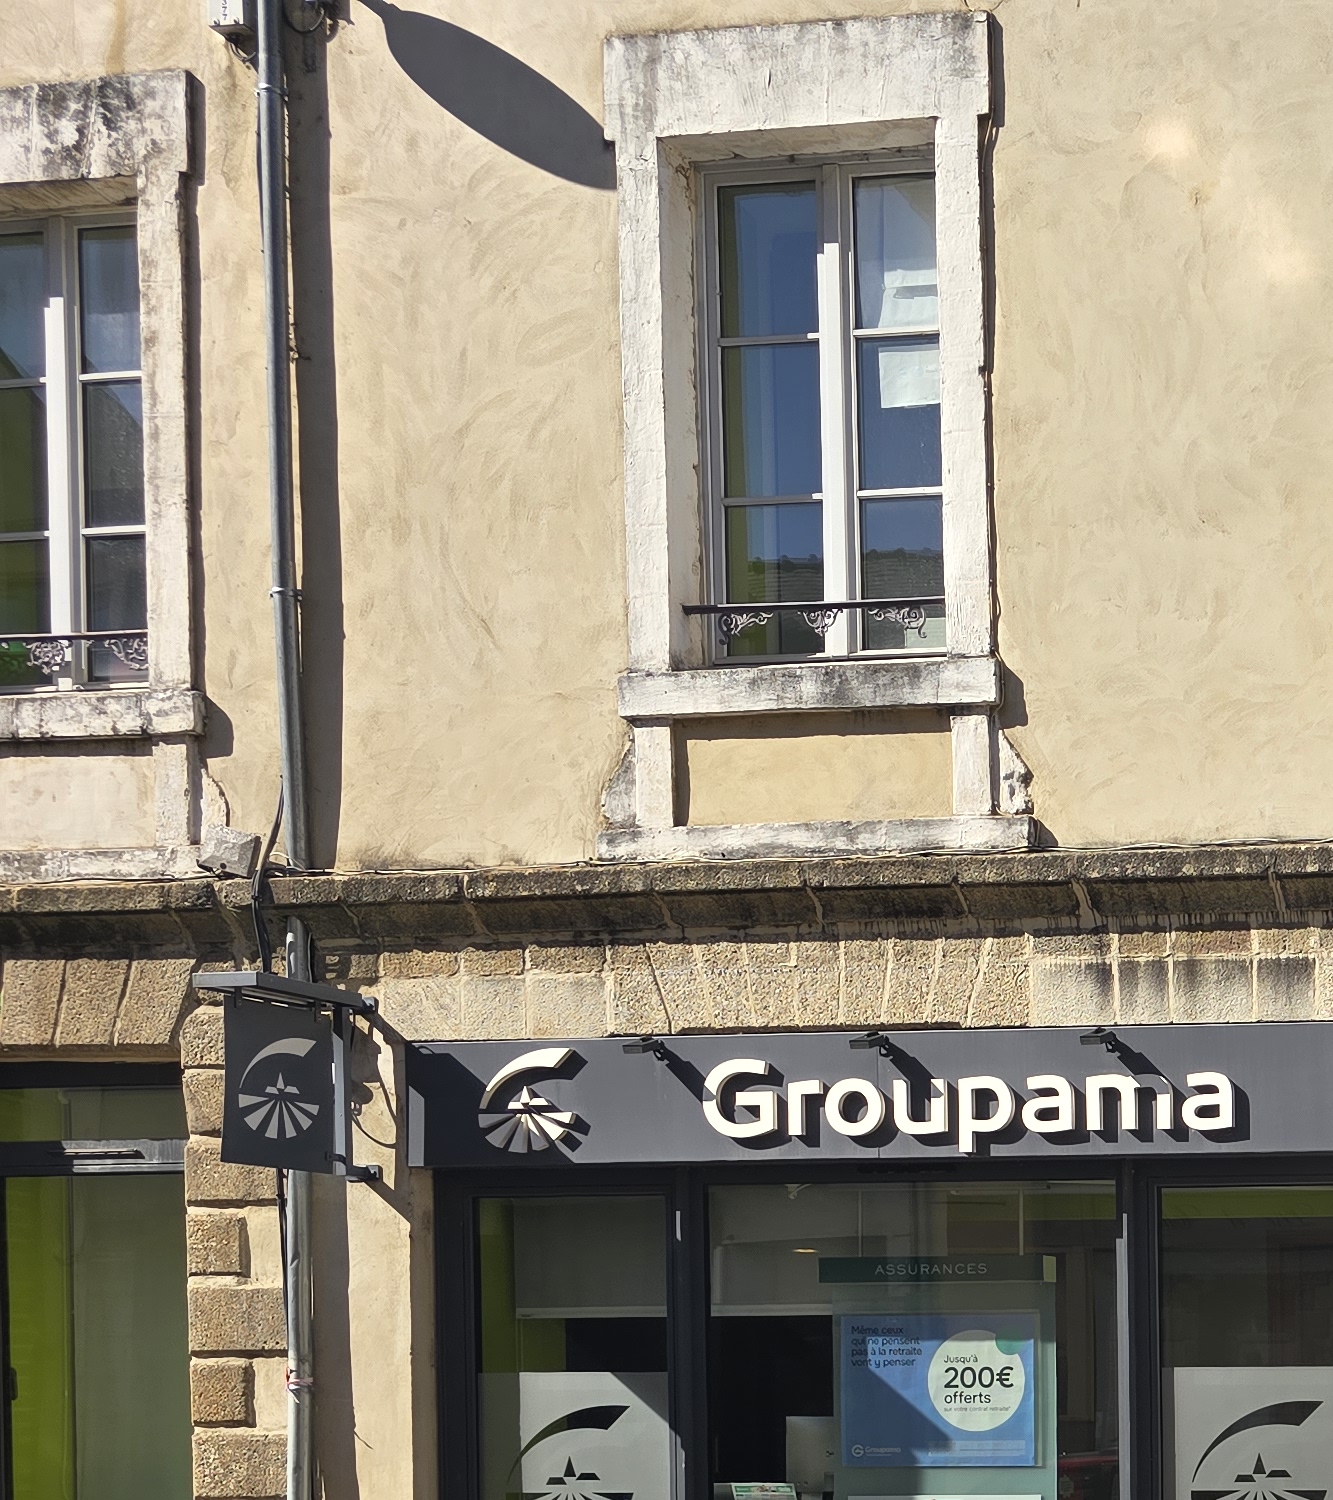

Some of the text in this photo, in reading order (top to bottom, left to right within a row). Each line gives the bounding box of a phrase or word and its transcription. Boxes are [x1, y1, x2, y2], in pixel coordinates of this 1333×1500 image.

[702, 1058, 1236, 1153] Groupama
[874, 1262, 988, 1275] ASSURANCES
[851, 1325, 879, 1334] Même
[851, 1337, 866, 1347] qui
[881, 1337, 920, 1347] pensent
[851, 1347, 922, 1357] pas à la retraite
[851, 1358, 916, 1368] vont y penser
[944, 1354, 978, 1364] Jusqu'à
[944, 1366, 1014, 1388] 200€
[944, 1391, 991, 1404] offerts
[865, 1445, 901, 1454] Groupama
